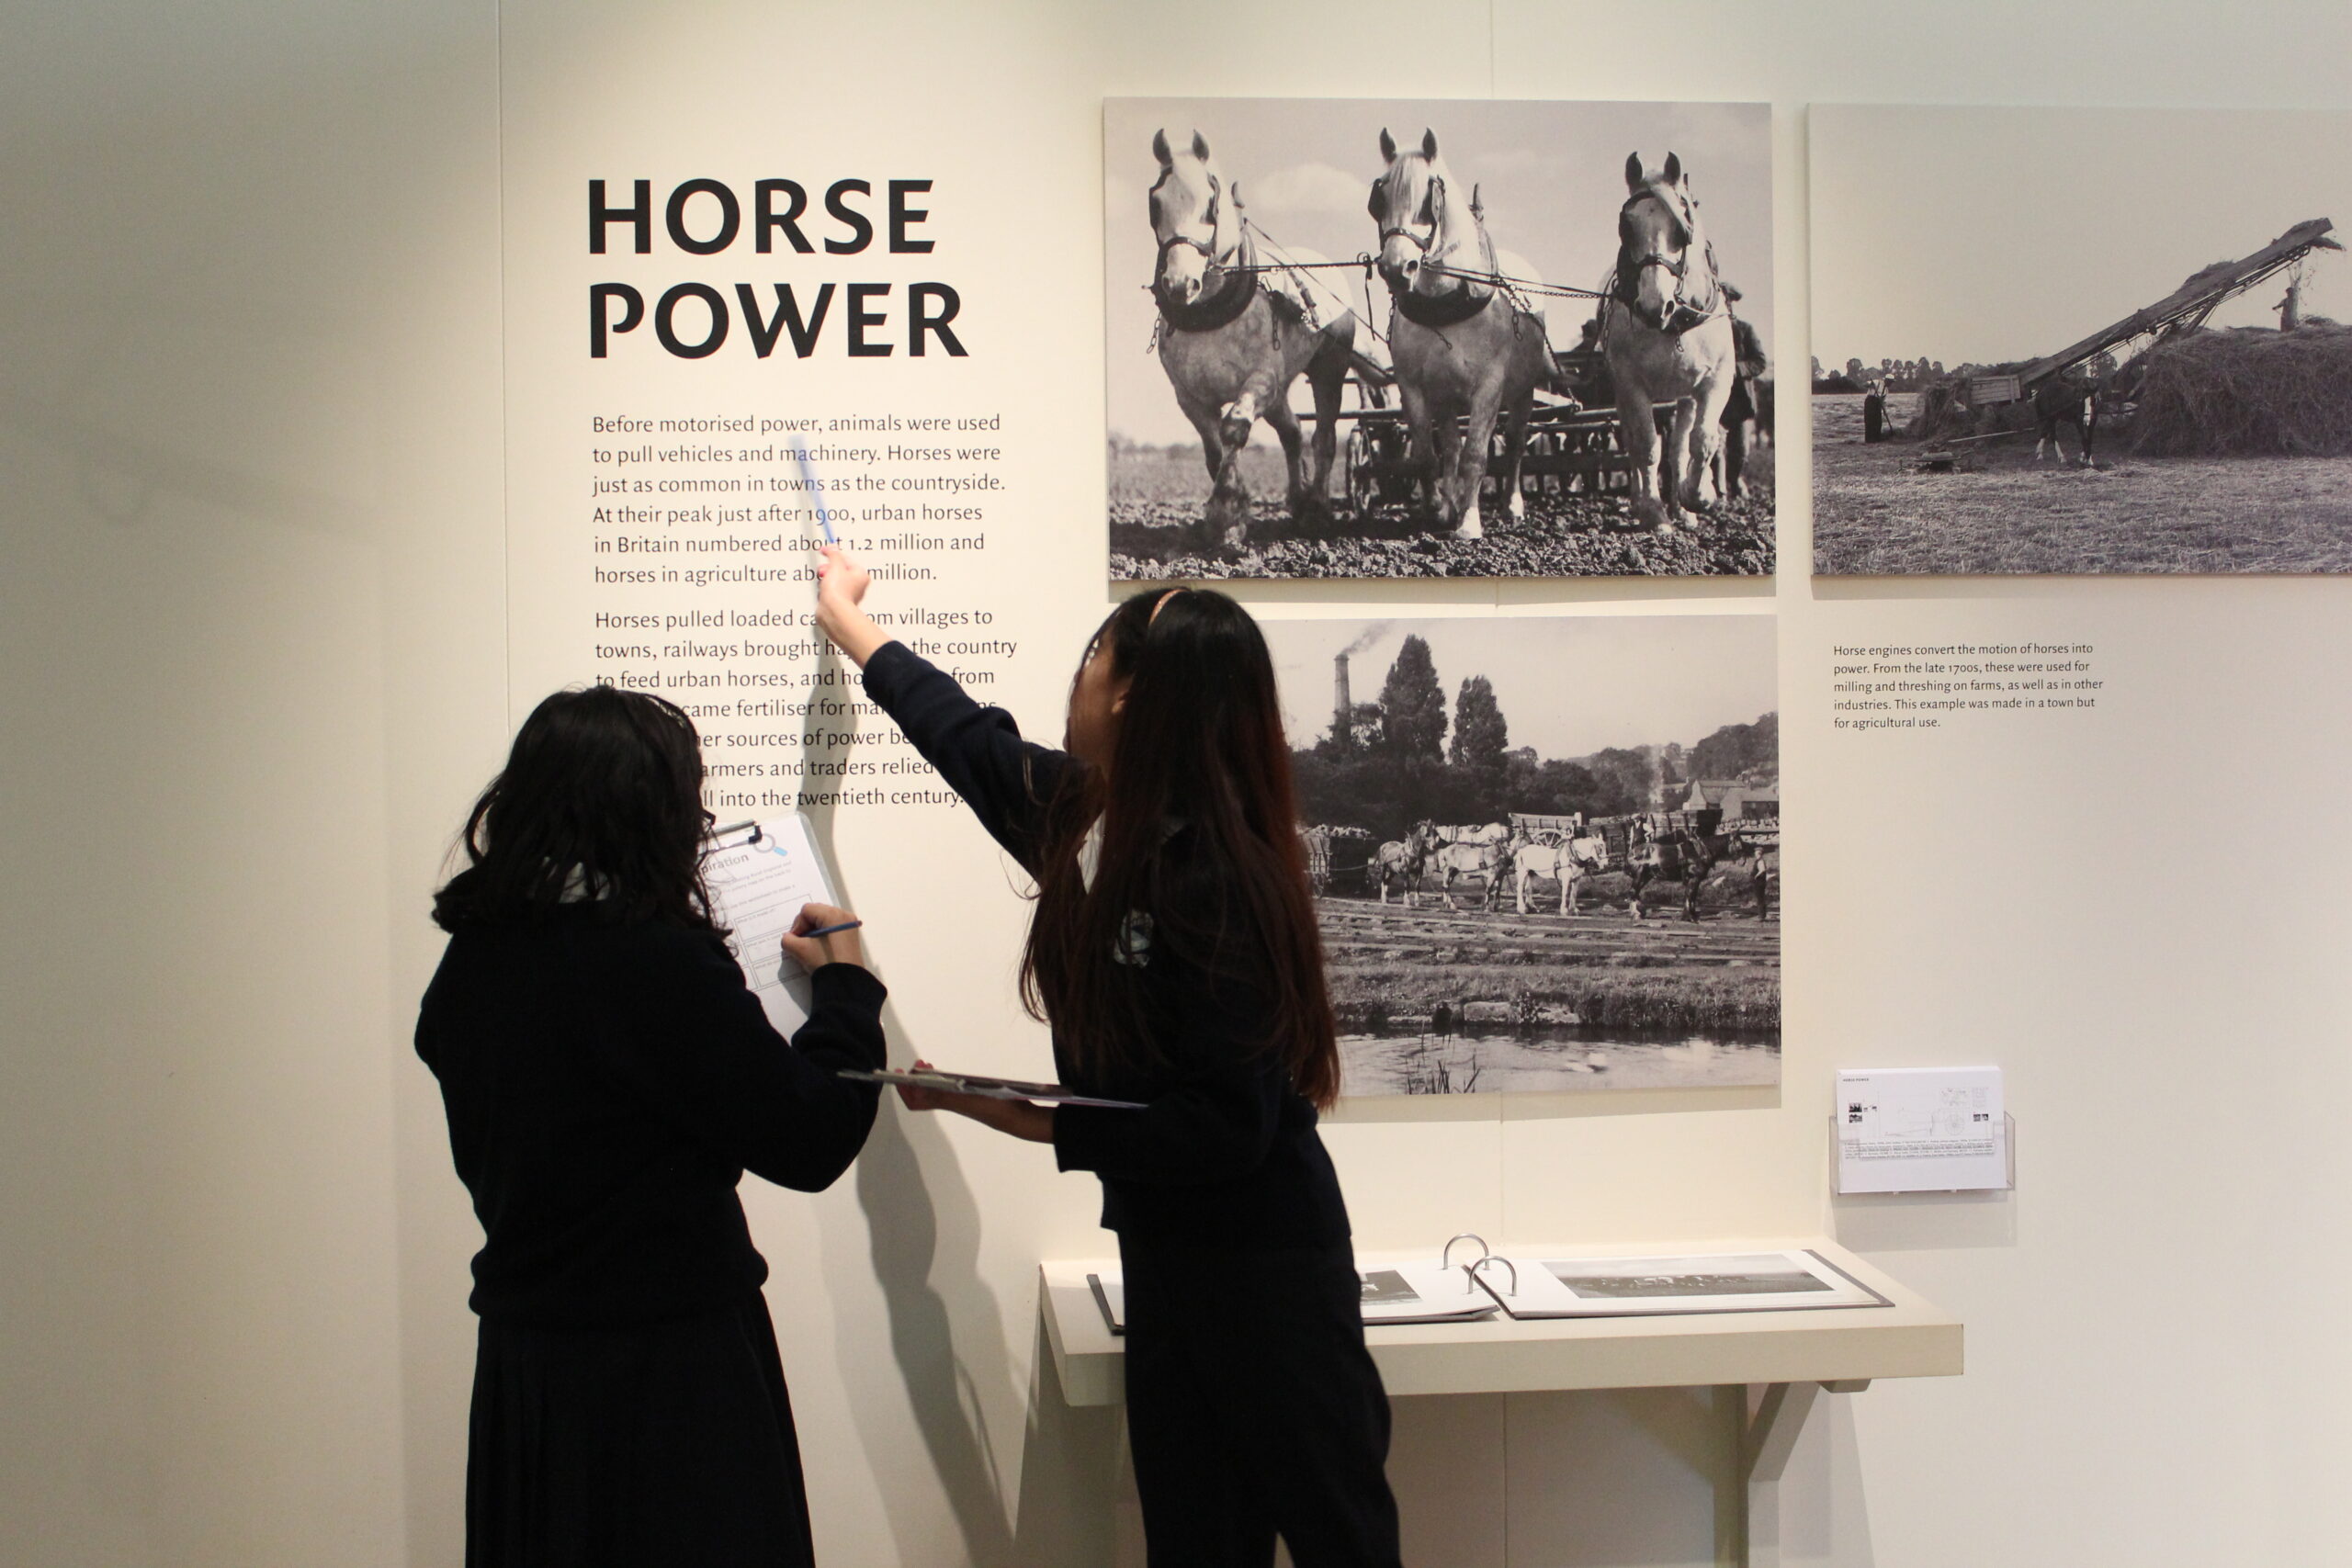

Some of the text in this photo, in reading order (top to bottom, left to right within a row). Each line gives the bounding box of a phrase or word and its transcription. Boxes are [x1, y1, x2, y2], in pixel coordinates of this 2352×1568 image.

[589, 178, 935, 255] HORSE
[590, 282, 969, 359] POWER
[594, 413, 1000, 436] Before motorised power, animals were used
[593, 444, 1001, 467] to pull vehicles and machinery. Horses were
[592, 473, 1005, 497] just as common in towns as the countryside.
[593, 503, 982, 527] At their peak just after 1900, urban horses
[595, 536, 610, 553] in
[618, 536, 679, 553] Britain
[686, 535, 781, 552] numbered
[849, 539, 873, 550] 1.2
[881, 533, 944, 550] million
[951, 533, 984, 549] and
[595, 566, 655, 583] horses
[662, 566, 678, 582] in
[684, 565, 786, 587] agriculture
[867, 563, 936, 580] million.
[596, 612, 660, 628] Horses
[666, 610, 723, 632] pulled
[731, 609, 793, 626] loaded
[899, 608, 968, 629] villages
[974, 610, 992, 624] to
[595, 644, 657, 660] towns,
[664, 640, 738, 661] railways
[745, 639, 820, 660] brought
[912, 637, 941, 654] the
[947, 640, 1017, 658] country
[1834, 643, 2093, 658] Horse engines convert the motion of horses into
[595, 674, 614, 689] to
[620, 671, 660, 688] feed
[667, 670, 720, 687] urban
[729, 670, 794, 689] horses,
[800, 669, 834, 686] and
[952, 667, 994, 684] from
[1834, 666, 1870, 676] power.
[1873, 663, 1901, 673] From
[1905, 662, 1922, 673] the
[1926, 662, 1945, 672] late
[1949, 664, 1982, 675] 1700s,
[1984, 661, 2014, 672] these
[2046, 661, 2071, 671] used
[2075, 660, 2090, 671] for
[1834, 681, 1872, 694] milling
[1875, 681, 1895, 692] and
[1898, 680, 1951, 694] threshing
[1971, 680, 2005, 692] farms,
[2022, 679, 2043, 690] well
[2047, 682, 2058, 690] as
[2062, 679, 2071, 689] in
[2075, 678, 2103, 689] other
[684, 705, 730, 719] came
[737, 699, 815, 716] fertiliser
[820, 698, 846, 716] for
[1835, 699, 1891, 710] industries.
[1894, 698, 1917, 709] This
[1920, 698, 1965, 711] example
[1992, 697, 2021, 708] made
[2026, 697, 2035, 707] in
[2047, 698, 2073, 707] town
[2077, 696, 2095, 707] but
[1835, 717, 1849, 728] for
[1852, 716, 1915, 730] agricultural
[727, 734, 797, 747] sources
[803, 728, 824, 746] of
[828, 733, 885, 750] power
[701, 764, 763, 777] armers
[770, 759, 803, 776] and
[809, 758, 876, 775] traders
[703, 786, 967, 807] ll into the twentieth century.
[700, 853, 750, 875] piration
